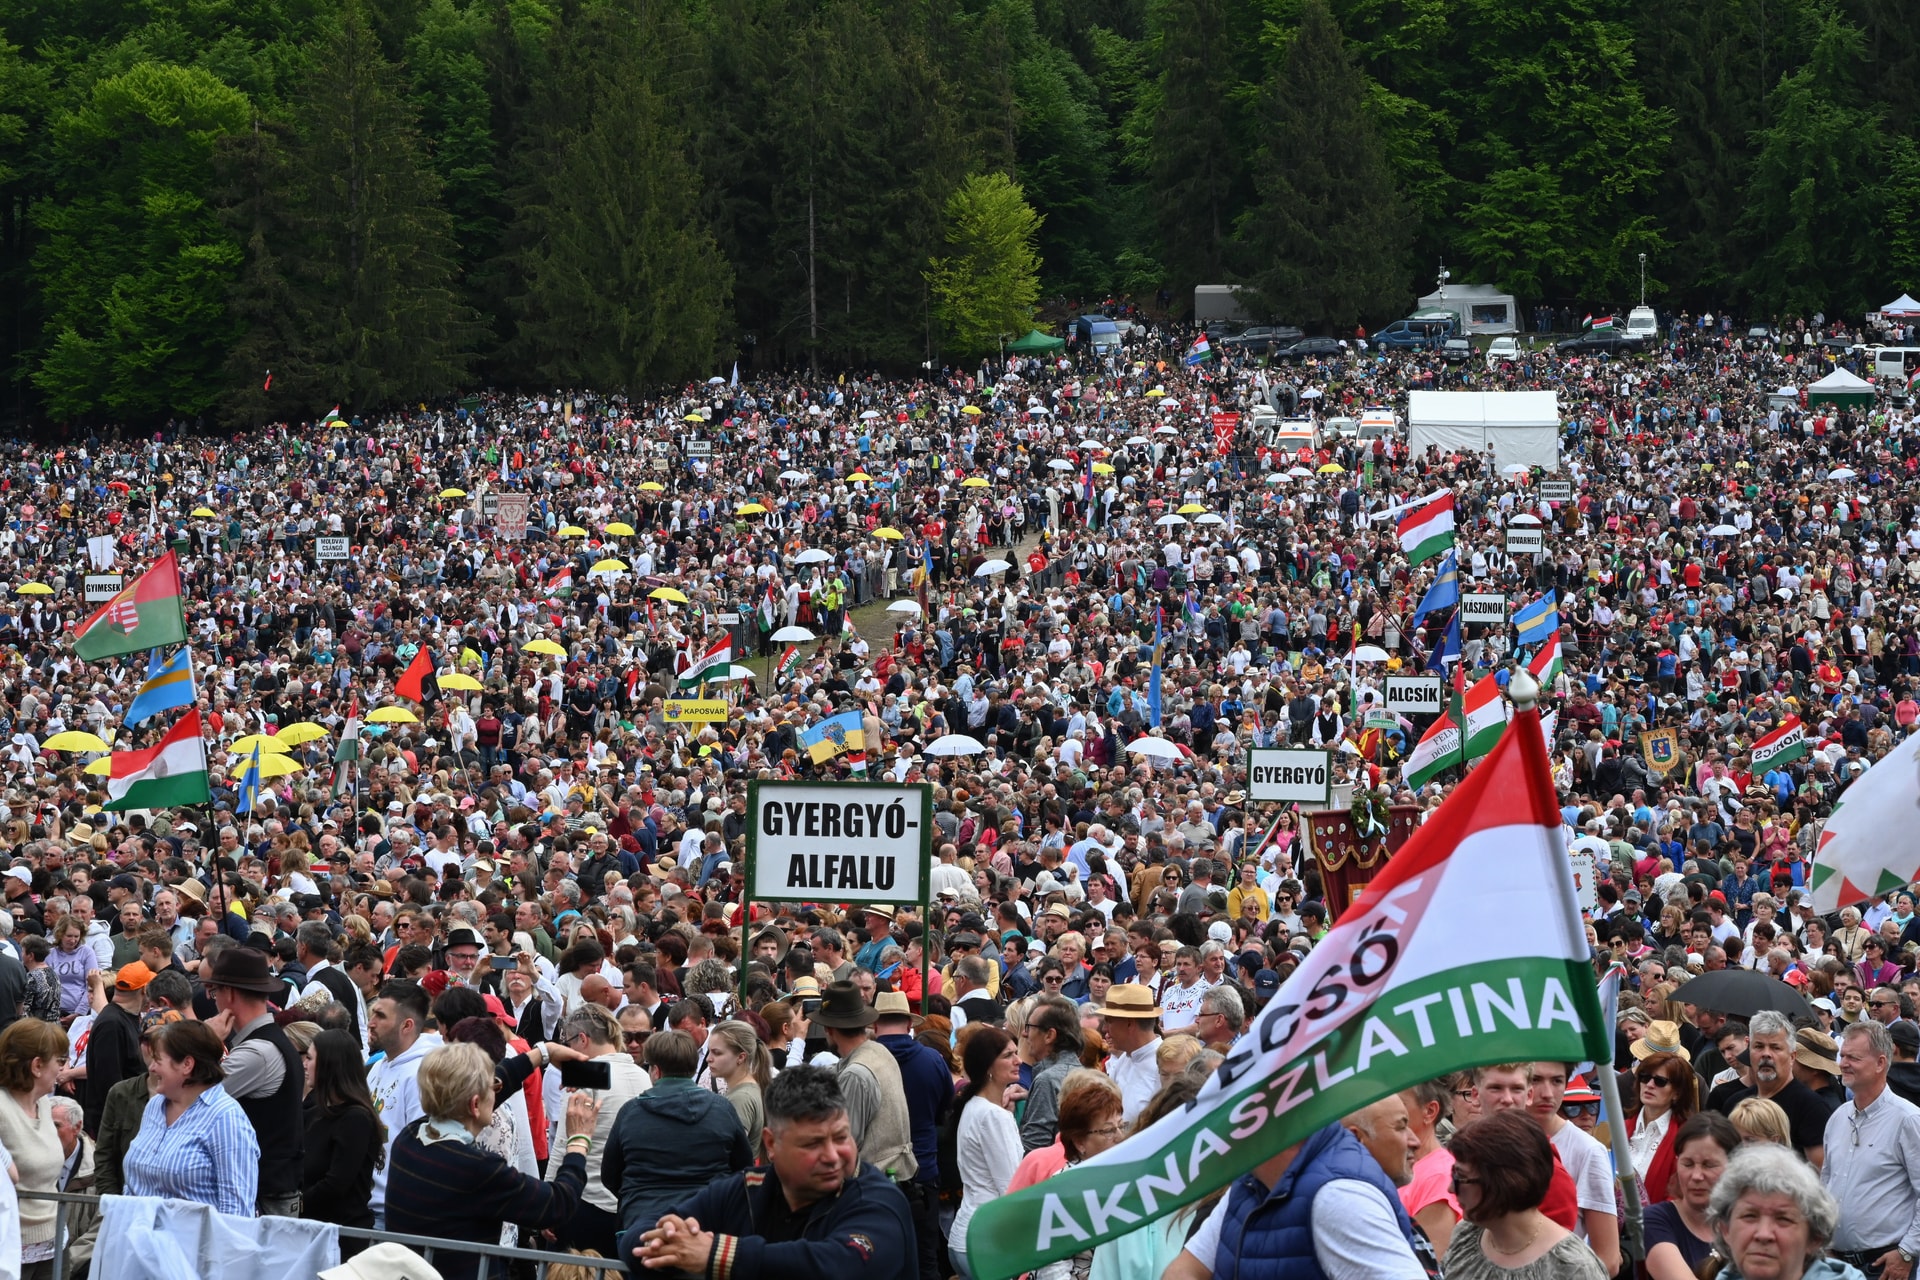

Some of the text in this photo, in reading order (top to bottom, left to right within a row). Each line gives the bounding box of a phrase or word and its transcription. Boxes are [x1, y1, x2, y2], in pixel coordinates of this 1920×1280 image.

[1507, 536, 1541, 545] UDVARHELY
[86, 583, 121, 593] GYIMESEK
[1463, 599, 1503, 614] KÁSZONOK
[1388, 683, 1438, 703] ALCSÍK
[684, 706, 725, 715] KAPOSVÁR
[1647, 731, 1671, 740] PÁPA
[1253, 764, 1325, 785] GYERGYÓ
[763, 797, 918, 839] GYERGYÓ-
[787, 854, 895, 891] ALFALU
[1036, 977, 1587, 1252] AKNASZLATINA
